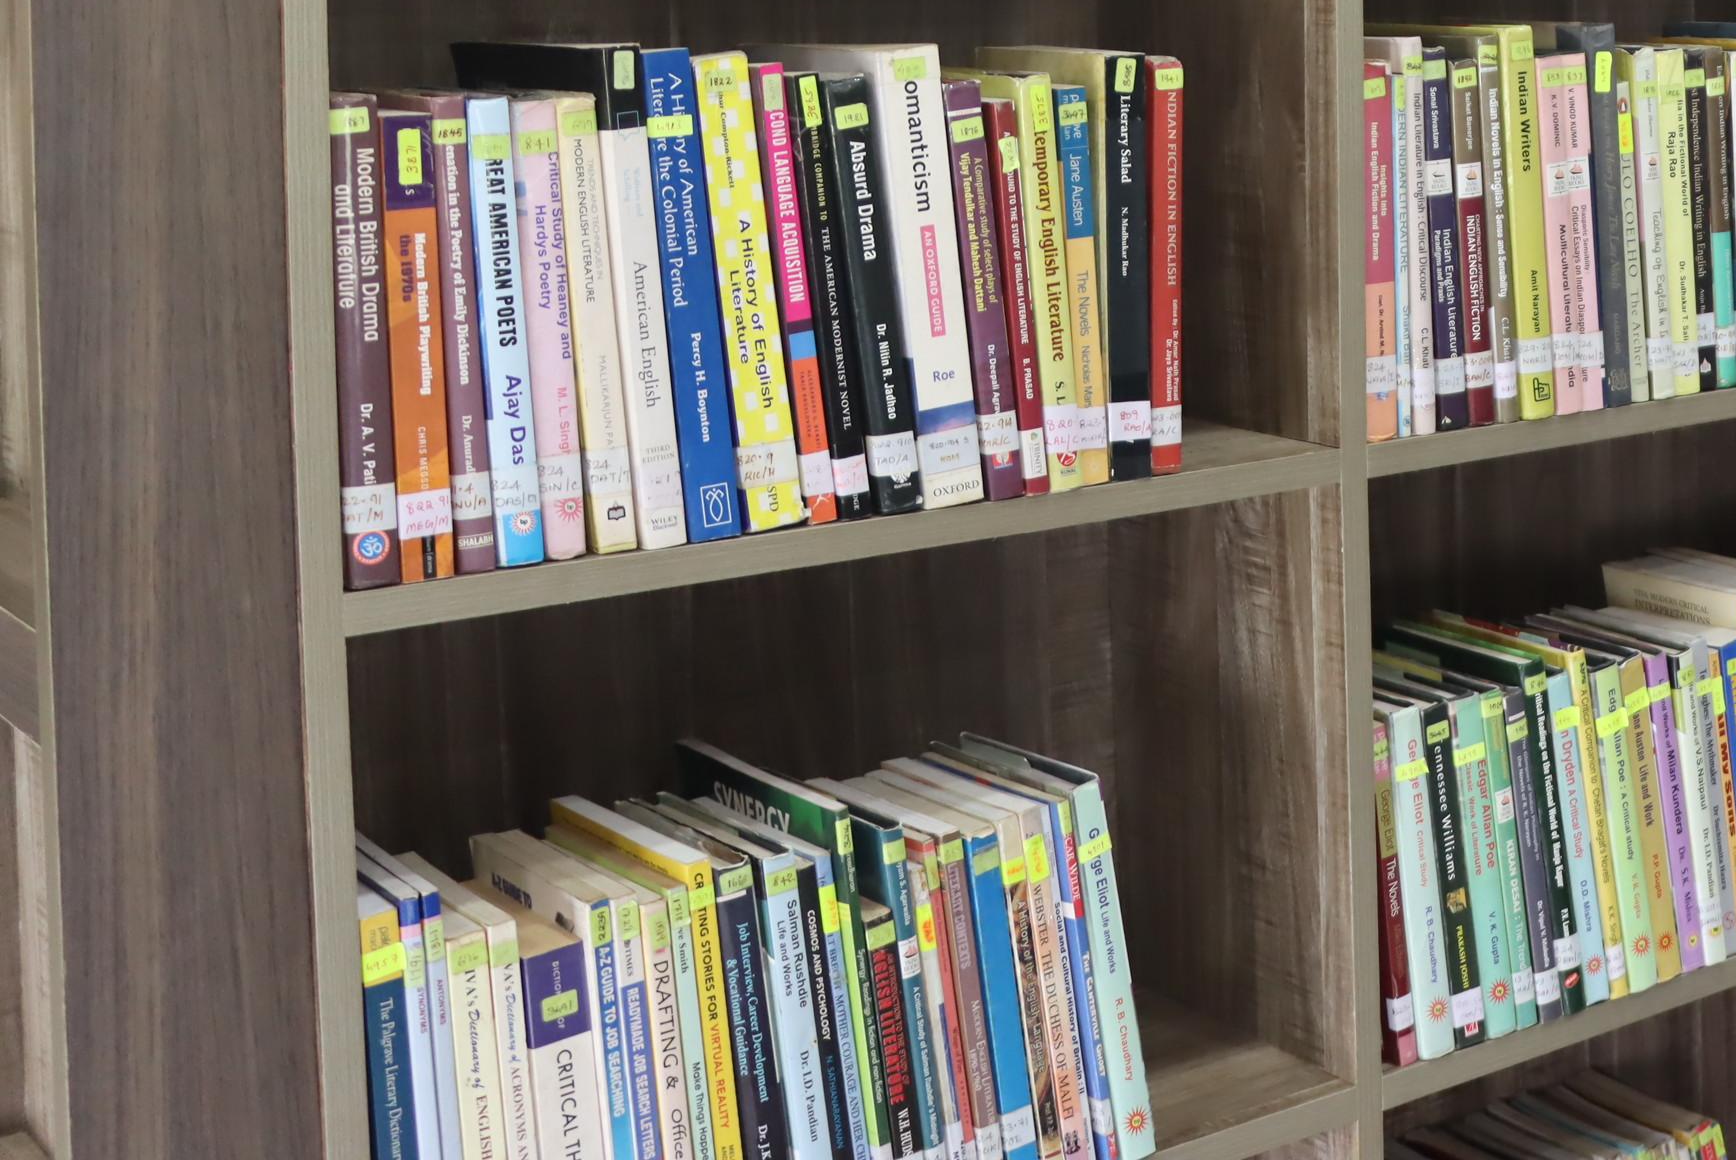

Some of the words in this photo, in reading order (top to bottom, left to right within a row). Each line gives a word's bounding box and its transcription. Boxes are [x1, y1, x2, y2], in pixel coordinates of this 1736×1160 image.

[1517, 71, 1532, 114] Indian
[1118, 95, 1132, 146] Literary
[1667, 131, 1677, 155] Raja
[849, 140, 872, 199] Absurd
[1120, 150, 1133, 183] Salad
[1521, 119, 1535, 172] Writers
[1668, 158, 1678, 178] Rao
[335, 184, 353, 219] and
[356, 148, 378, 215] Modern
[773, 151, 796, 219] LANGUAGE
[360, 221, 379, 275] British
[400, 234, 412, 255] the
[489, 202, 513, 290] AMERICAN
[534, 204, 551, 256] Hardys
[739, 219, 751, 233] A
[856, 205, 879, 260] Drama
[1038, 218, 1058, 277] English
[1442, 229, 1454, 262] Indian
[1468, 215, 1478, 252] INDIAN
[1623, 197, 1639, 278] COELHO
[336, 225, 358, 309] Literature
[414, 233, 427, 276] Modern
[741, 238, 758, 305] History
[780, 223, 805, 303] ACQUISITION
[1469, 254, 1480, 297] ENGLISH
[400, 260, 415, 302] 1970s
[417, 280, 429, 320] British
[536, 261, 553, 309] Poetry
[633, 261, 653, 341] American
[1444, 266, 1456, 304] English
[362, 281, 381, 341] Drama
[496, 295, 518, 347] POETS
[730, 270, 751, 364] Literature
[749, 312, 764, 333] of
[1045, 281, 1068, 361] Literature
[1448, 307, 1459, 359] Literature
[1471, 299, 1482, 341] FICTION
[418, 325, 433, 395] Playwriting
[641, 346, 660, 408] English
[753, 338, 775, 409] English
[933, 371, 956, 383] Roe
[502, 374, 525, 422] Ajay
[508, 427, 528, 465] Das
[933, 480, 980, 497] OXFORD
[1477, 759, 1490, 801] Edgar
[1667, 749, 1678, 781] Milan
[1481, 805, 1494, 839] Allan
[1670, 784, 1685, 834] Kundera
[1440, 814, 1457, 881] Williams
[1485, 843, 1497, 868] Poe
[786, 900, 801, 948] Salman
[806, 910, 818, 951] COSMOS
[701, 941, 713, 993] STORIES
[792, 952, 808, 1008] Rushdie
[812, 953, 822, 974] AND
[1040, 951, 1054, 982] THE
[380, 997, 394, 1019] The
[654, 961, 678, 1068] DRAFTING
[706, 996, 717, 1020] FOR
[813, 976, 831, 1040] PSYCHOLOGY
[1043, 985, 1063, 1051] DUCHESS
[378, 1021, 399, 1063] Palgrave
[634, 1054, 648, 1073] JOB
[709, 1024, 723, 1076] VIRTUAL
[1054, 1054, 1067, 1072] OF
[382, 1065, 401, 1107] Literary
[556, 1049, 580, 1136] CRITICAL
[636, 1075, 651, 1116] SEARCH
[715, 1079, 729, 1128] REALITY
[1058, 1075, 1073, 1120] MALFI
[640, 1118, 656, 1159] LETTERS
